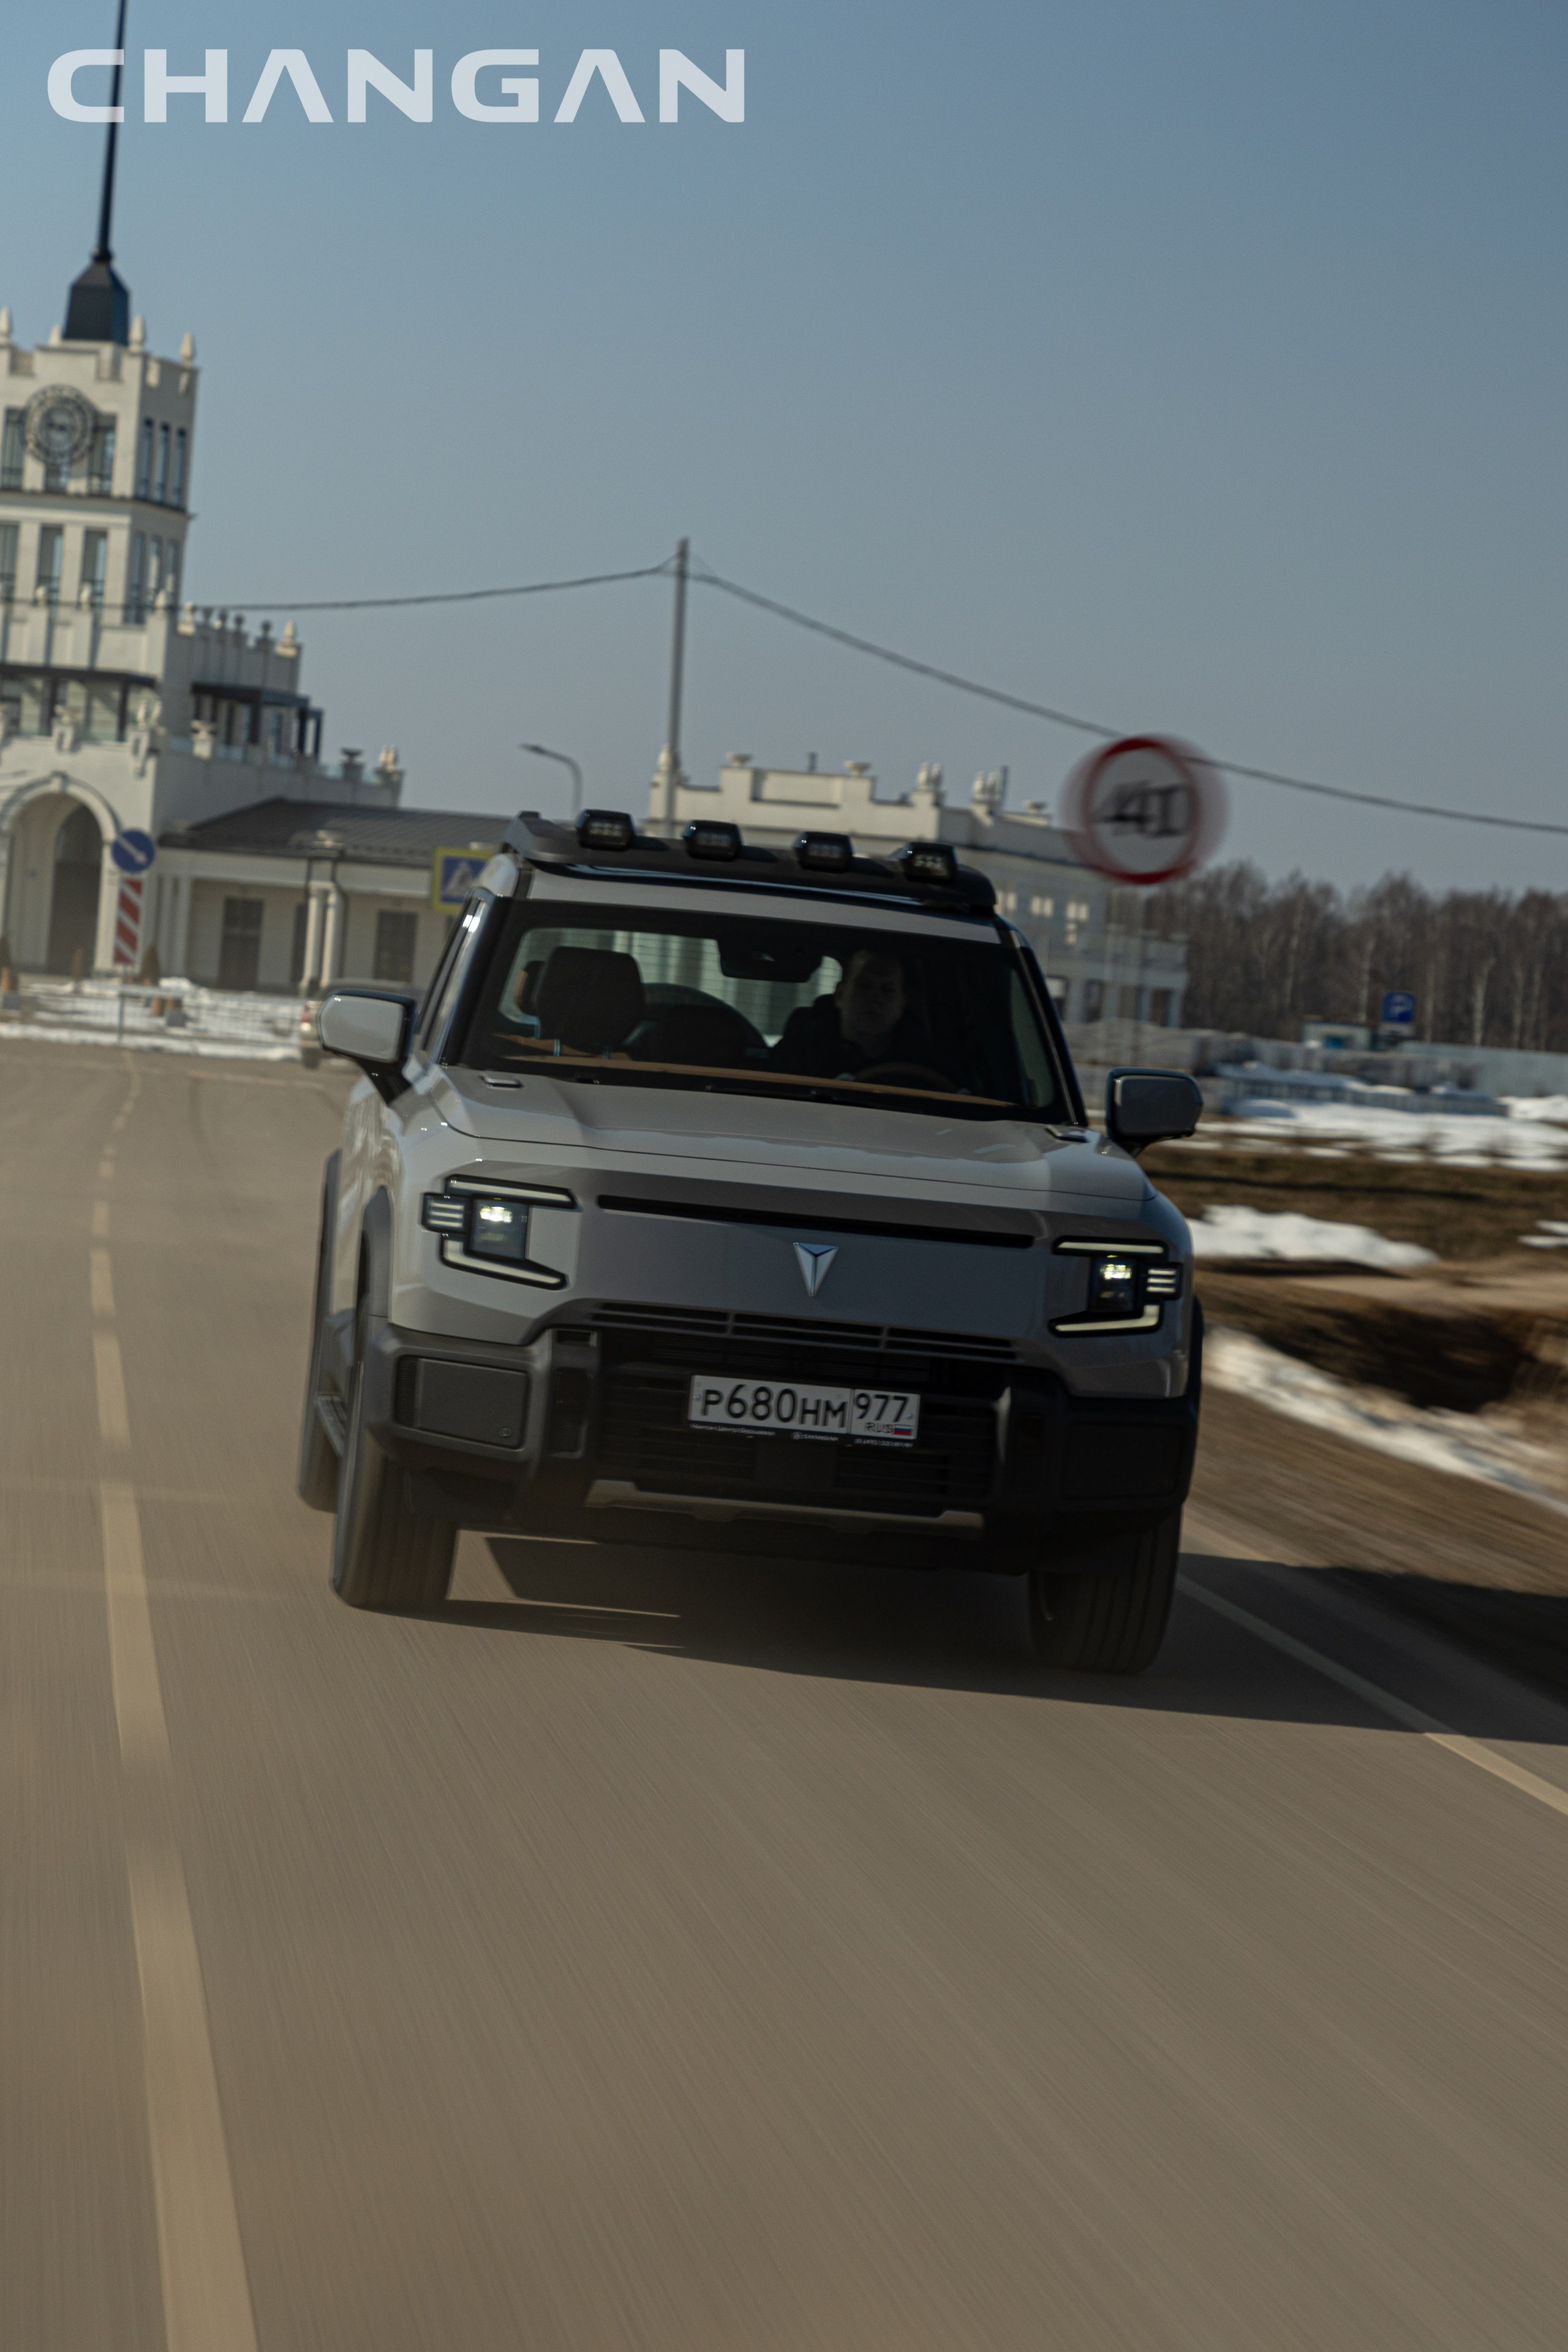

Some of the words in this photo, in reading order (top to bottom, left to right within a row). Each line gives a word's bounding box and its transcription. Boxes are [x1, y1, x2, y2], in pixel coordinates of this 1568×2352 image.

[700, 1384, 848, 1428] Р680НМ
[853, 1392, 910, 1423] 977
[864, 1422, 894, 1434] RUS
